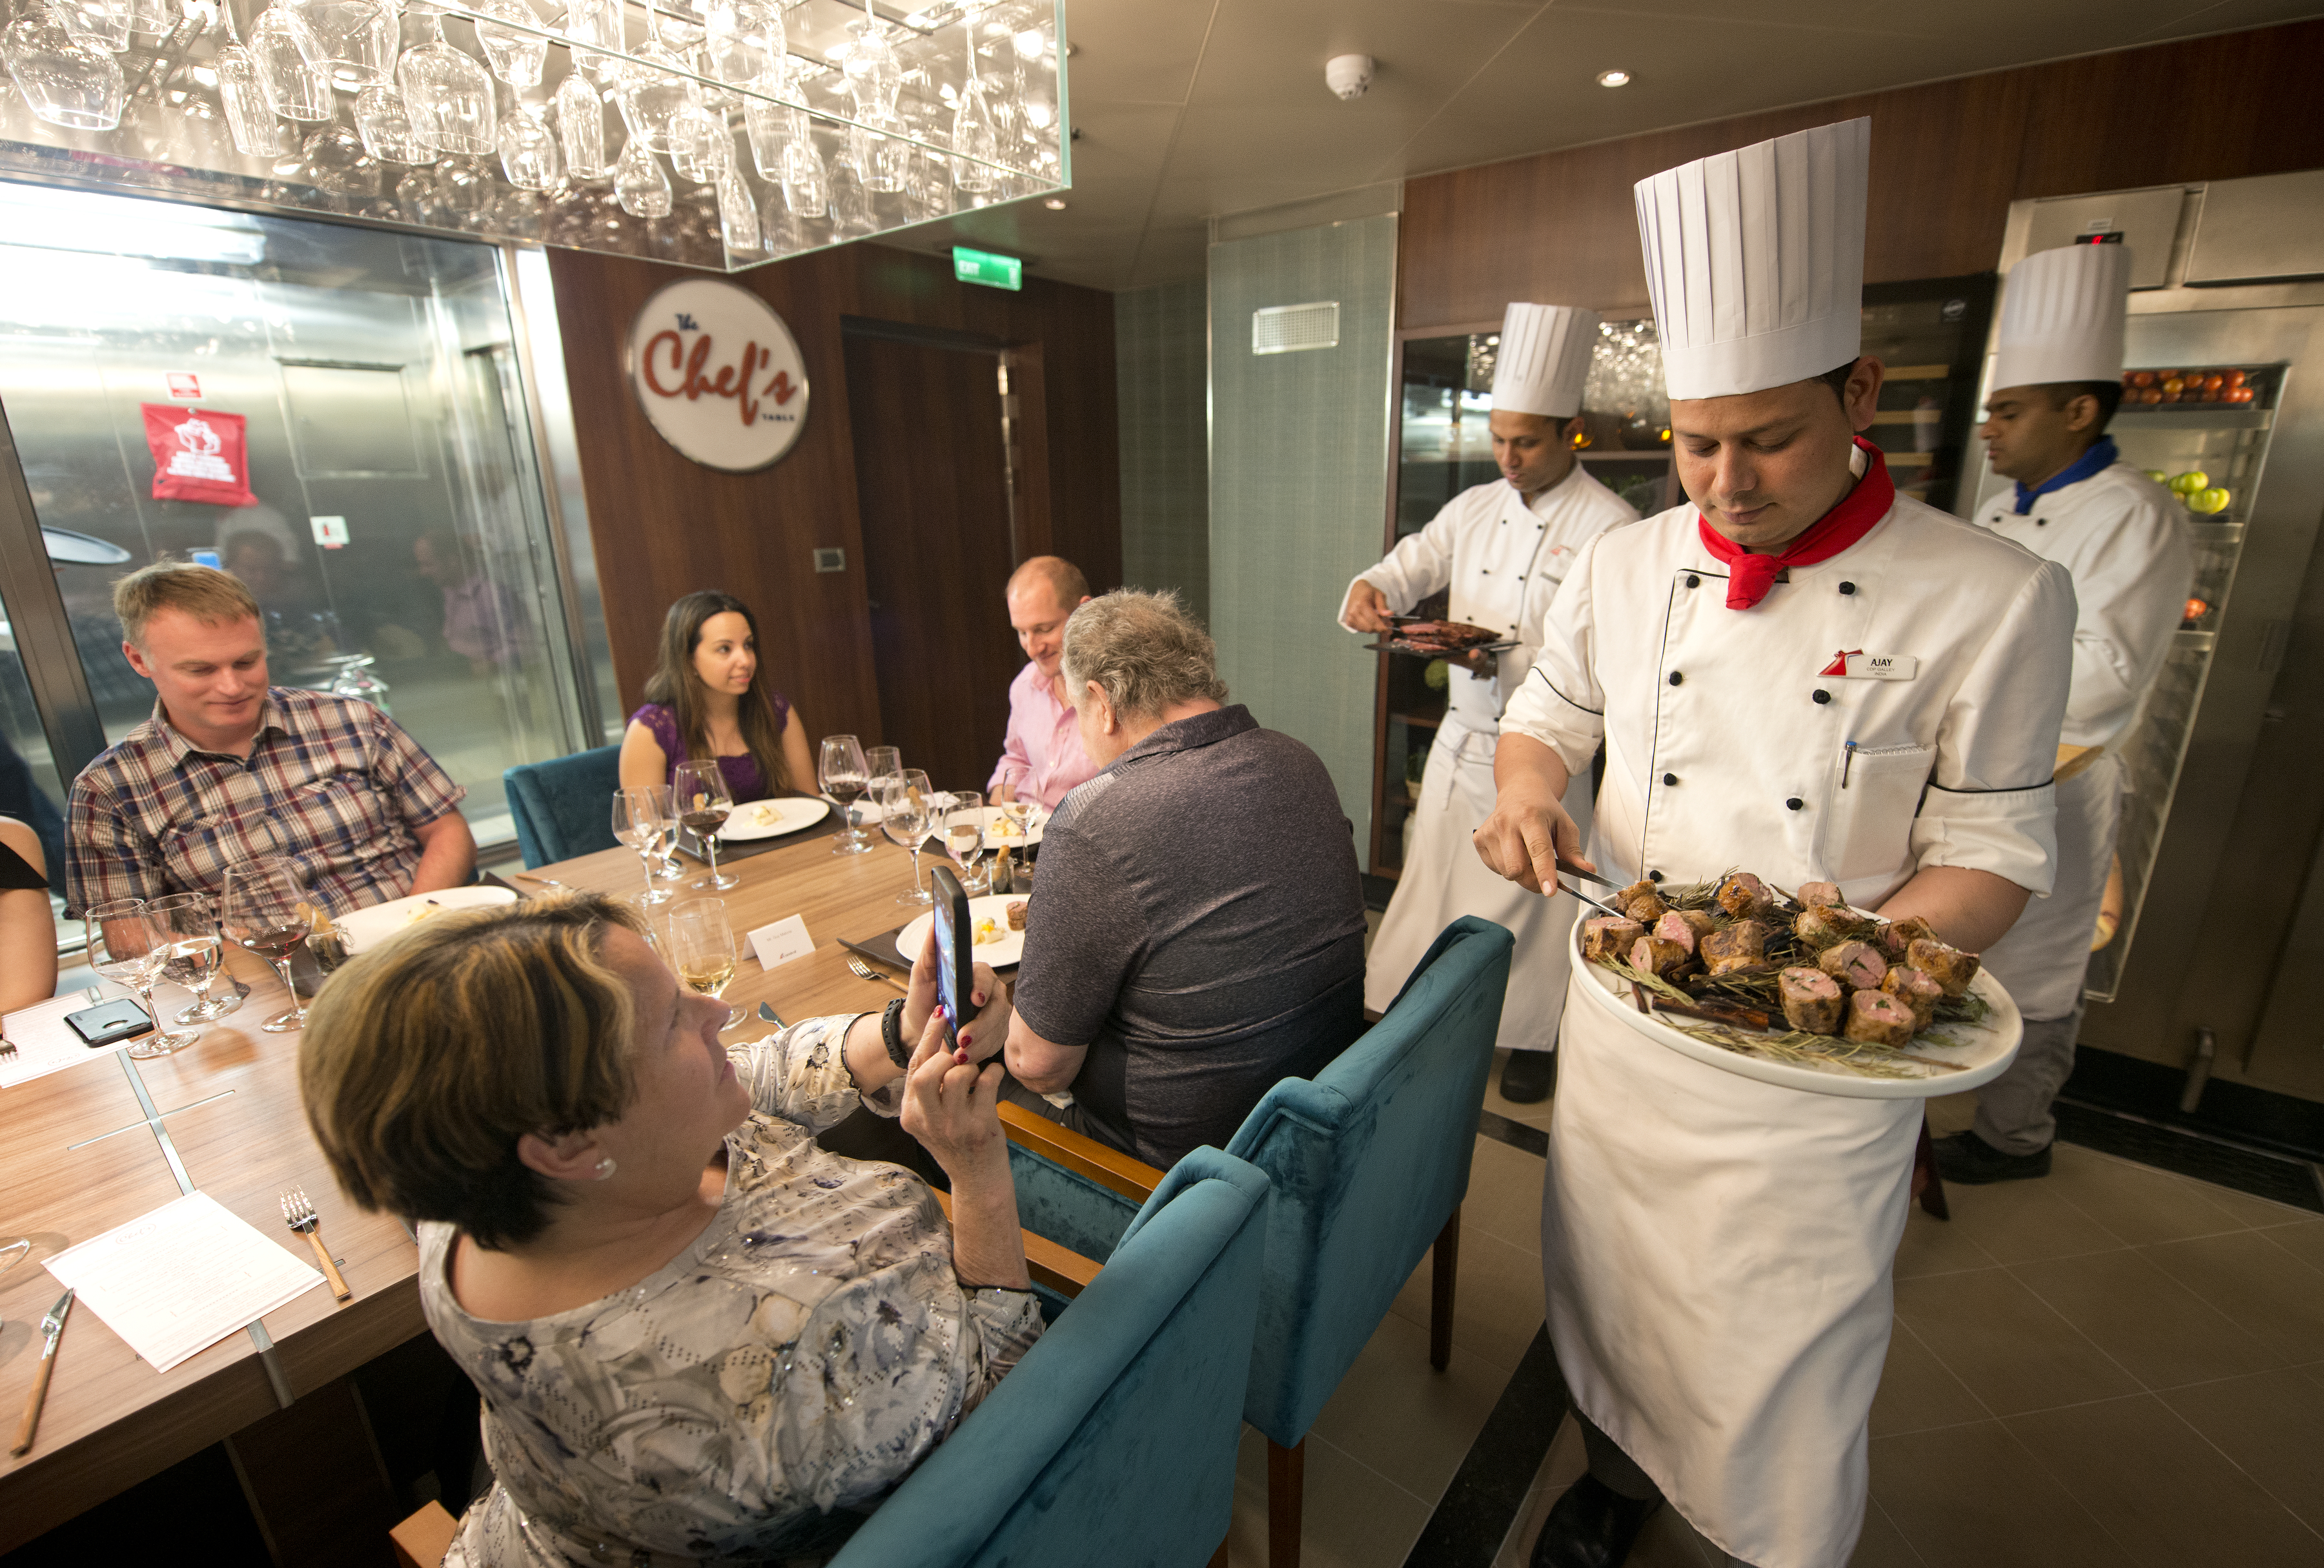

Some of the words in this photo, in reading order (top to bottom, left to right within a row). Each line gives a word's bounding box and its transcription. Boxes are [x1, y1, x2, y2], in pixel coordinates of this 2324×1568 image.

[675, 312, 698, 331] The
[644, 331, 798, 426] Chef's
[762, 413, 795, 422] TABLE
